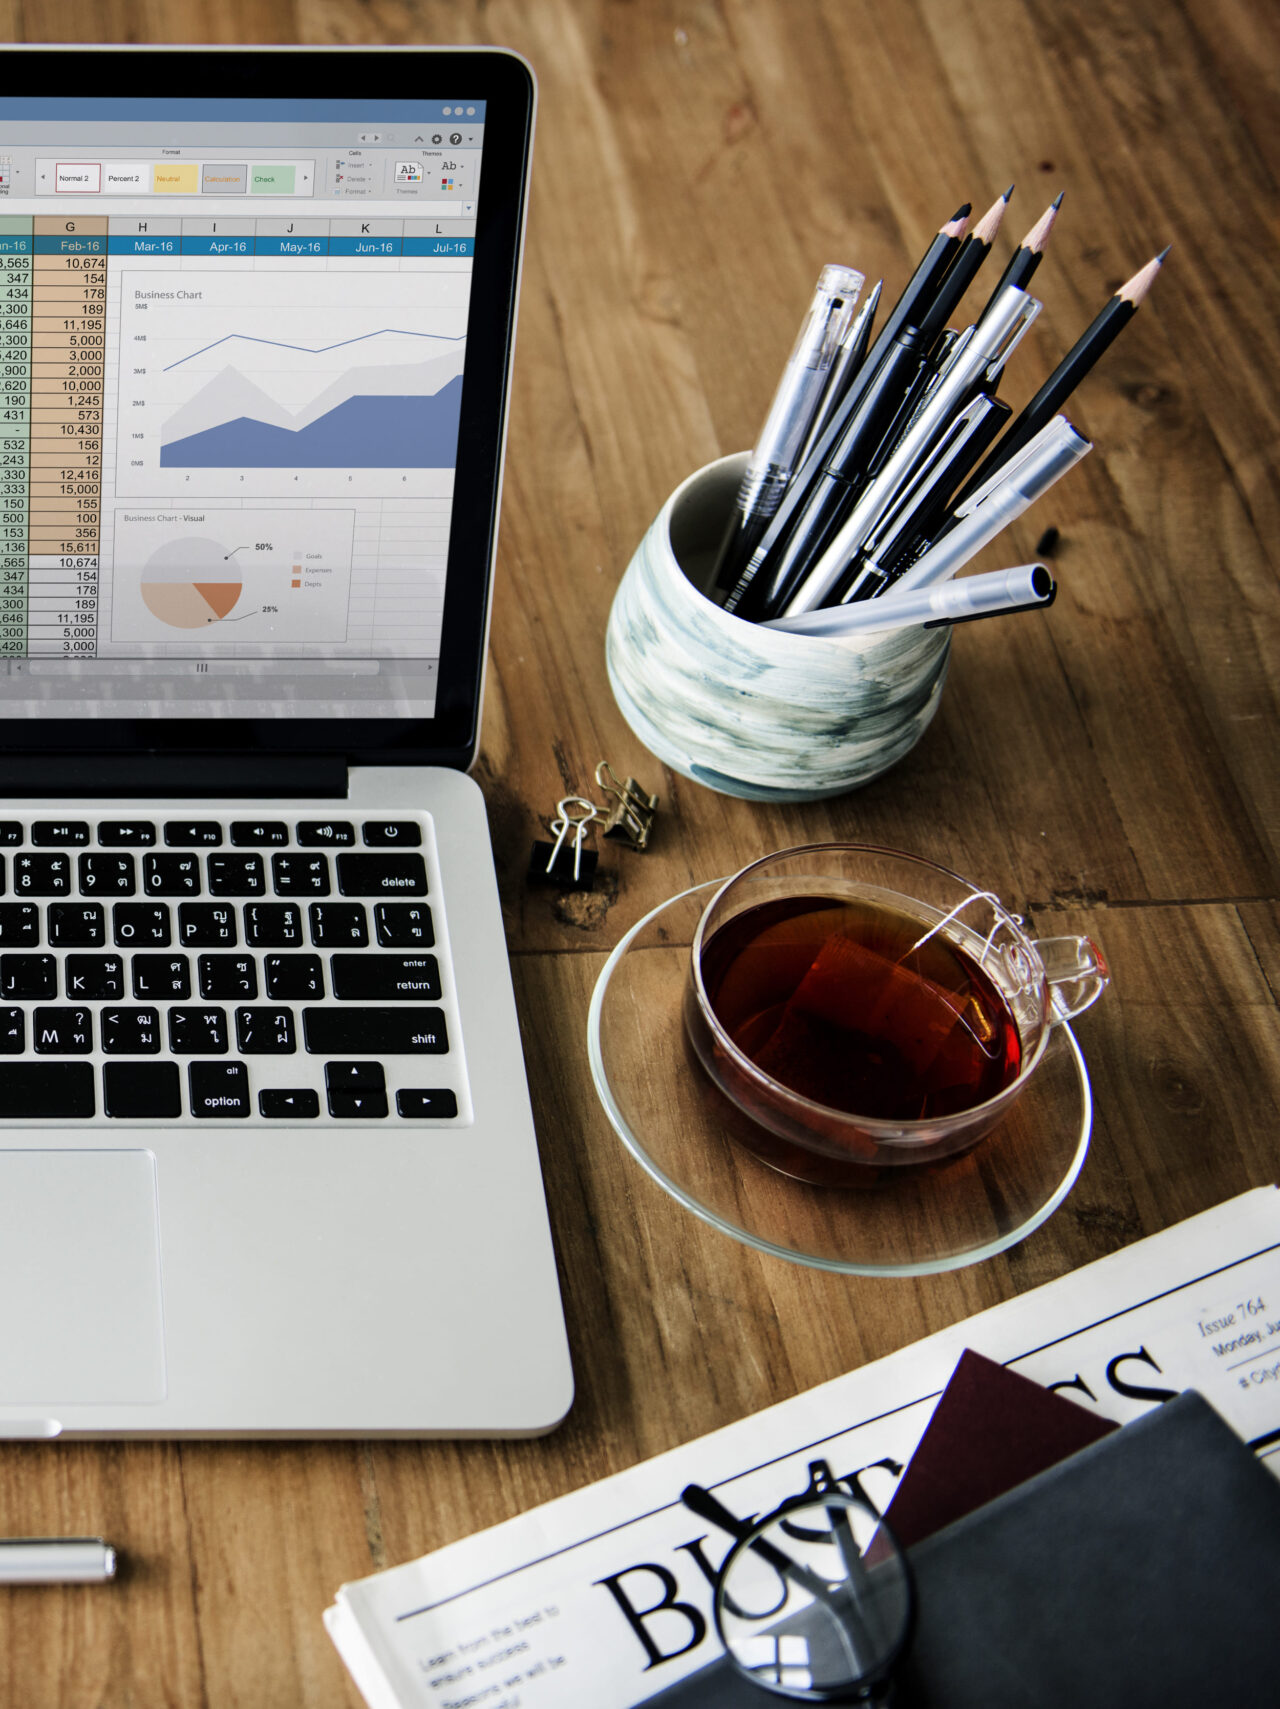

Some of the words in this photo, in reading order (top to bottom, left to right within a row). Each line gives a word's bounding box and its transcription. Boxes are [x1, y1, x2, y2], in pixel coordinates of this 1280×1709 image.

[107, 175, 134, 183] Percent
[134, 175, 140, 183] 2
[156, 175, 181, 183] Neutral
[204, 175, 241, 183] Calculation
[253, 175, 275, 183] Check
[61, 241, 99, 251] Feb-16
[135, 242, 172, 251] Mar-16
[210, 242, 246, 253] Apr-16
[280, 242, 320, 254] May-16
[356, 243, 392, 252] Jun-16
[433, 243, 466, 252] Jul-16
[66, 258, 105, 270] 10,674
[135, 290, 174, 299] Business
[176, 290, 203, 300] Chart
[64, 320, 102, 331] 11,195
[61, 470, 98, 481] 12,416
[123, 514, 157, 523] Business
[156, 514, 178, 523] Chart
[182, 514, 205, 523] Visual
[254, 542, 274, 551] 50%
[305, 567, 333, 575] Expenses
[261, 605, 279, 613] 25%
[382, 878, 415, 886] delete
[121, 924, 134, 937] O
[187, 924, 196, 936] P
[397, 981, 430, 989] return
[412, 1034, 435, 1043] shift
[205, 1097, 240, 1107] option
[1197, 1312, 1236, 1338] Issue
[1236, 1296, 1266, 1320] 764
[428, 1665, 473, 1689] ensure
[476, 1641, 530, 1670] success
